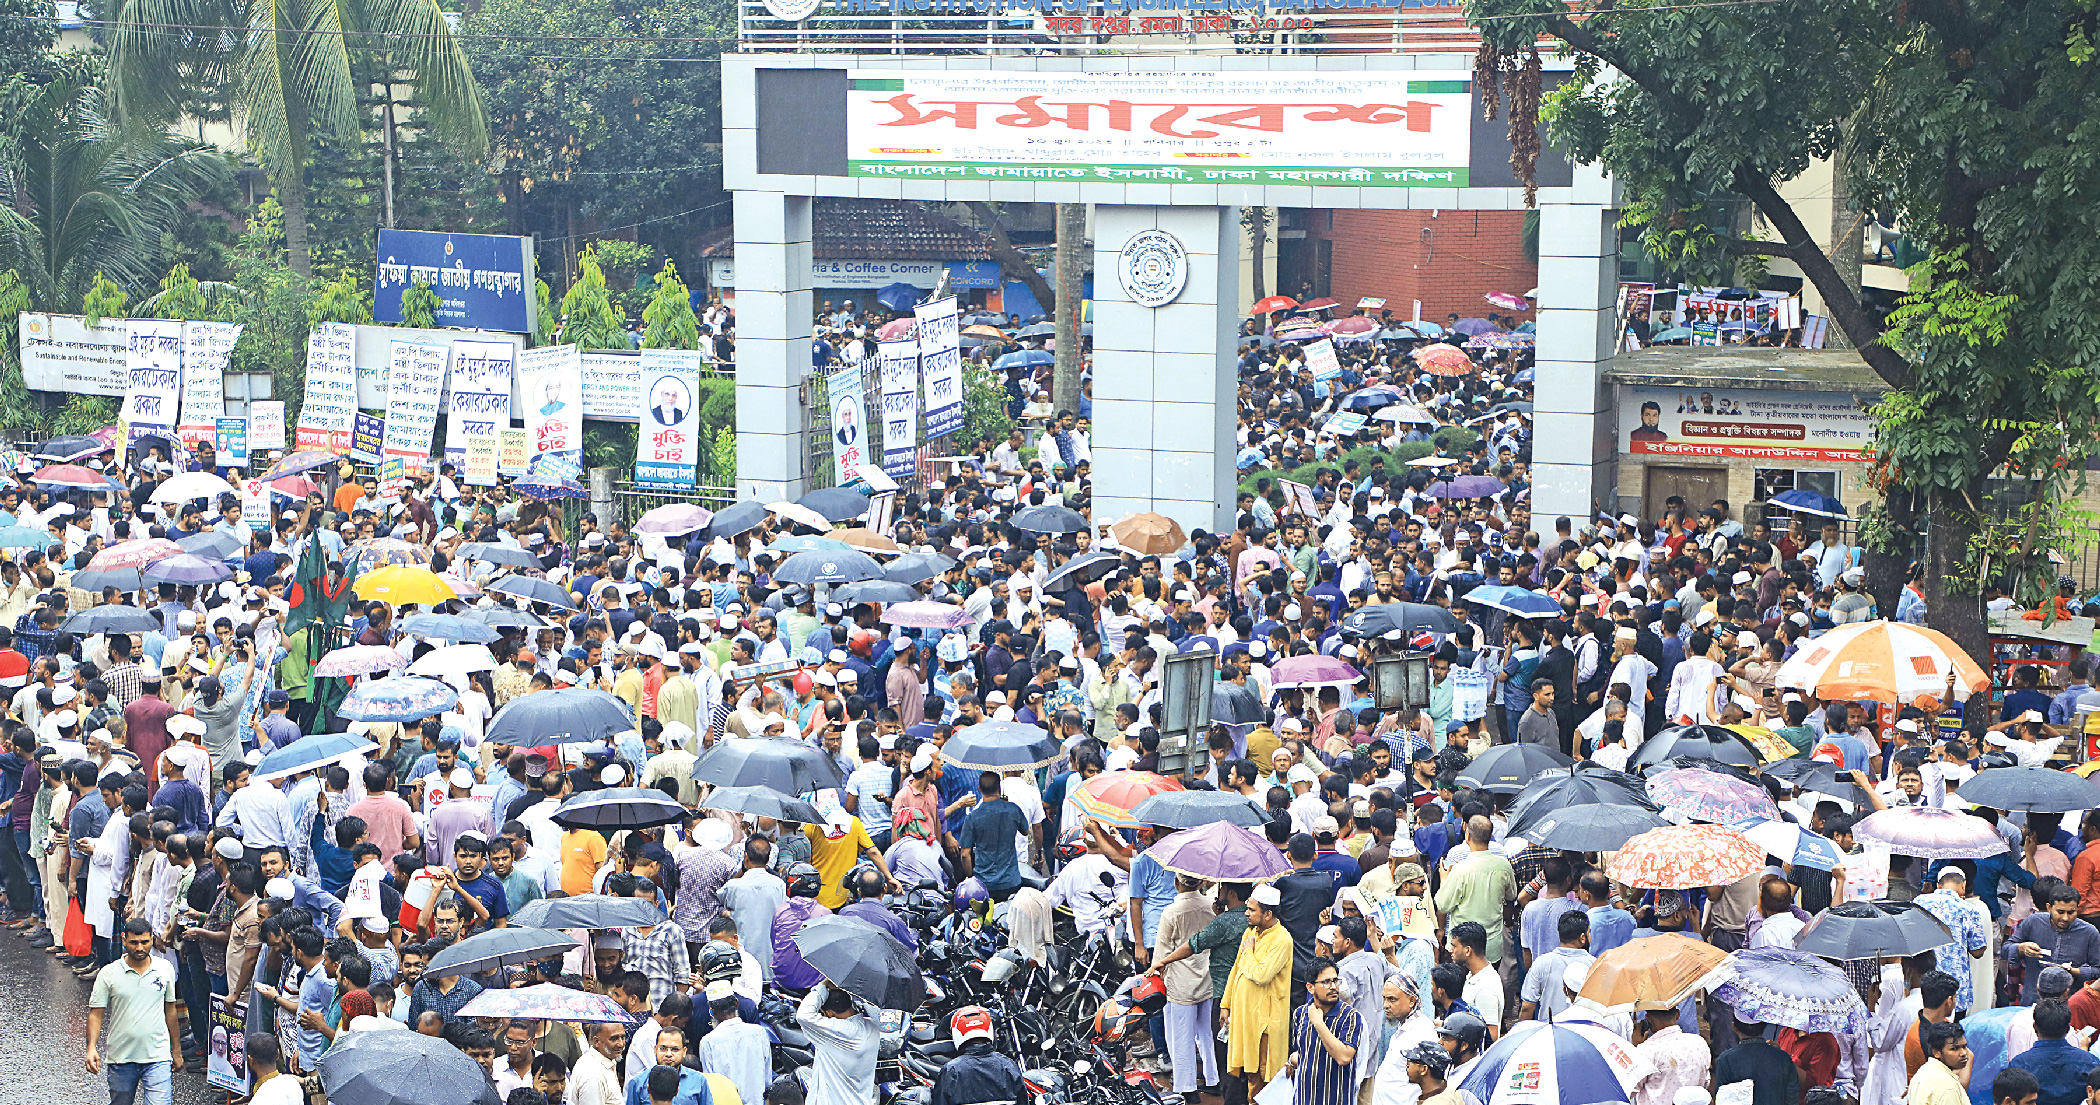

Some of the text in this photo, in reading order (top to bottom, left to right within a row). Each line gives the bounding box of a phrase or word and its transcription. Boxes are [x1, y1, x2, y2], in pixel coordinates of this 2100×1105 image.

[1043, 16, 1083, 35] সদর
[1192, 14, 1231, 35] ঢাকা
[1249, 16, 1313, 33] ১০০০
[869, 93, 1444, 139] সমাবেশ
[859, 164, 969, 177] বাংলাদেশ
[973, 165, 1089, 179] জামায়াতে
[1203, 169, 1260, 182] ঢাকা
[1265, 167, 1375, 183] মহানগরী
[1381, 169, 1457, 183] দক্ষিণ
[379, 255, 408, 289] সুফিয়া
[441, 259, 471, 291] জাতীয়
[812, 262, 935, 274] ria & Coffee Corner
[950, 276, 994, 286] CONCORD
[35, 351, 67, 361] Sustainable
[328, 351, 351, 362] টাকার
[413, 358, 440, 372] ছিলাম
[454, 352, 467, 378] এই
[488, 358, 511, 379] দরকার
[307, 380, 325, 389] দেশ
[393, 372, 440, 384] এক টাকার
[421, 386, 439, 397] নাই
[582, 383, 641, 393] NERGY AND POWER RES
[390, 399, 437, 413] দেশ রক্ষায়
[451, 384, 510, 415] কেয়ারটেকার
[389, 409, 415, 423] ইসলাম
[1818, 413, 1848, 421] বাংলাদেশ
[461, 419, 496, 437] সরকার
[535, 418, 569, 441] মুক্তি
[1685, 422, 1802, 438] বিজ্ঞান ও প্রযুক্তি বিষয়ক সম্পাদক
[1811, 428, 1838, 438] মনোনীত
[1839, 430, 1861, 439] হওয়ায়
[386, 433, 429, 451] বিকল্প নাই
[537, 435, 567, 452] চাই
[653, 428, 687, 448] মুক্তি
[653, 447, 683, 463] চাই
[840, 446, 860, 469] মুক্তি
[1644, 442, 1724, 455] ইঞ্জিনিয়ার
[1728, 444, 1820, 459] আলাউদ্দিন
[229, 1031, 245, 1052] মুক্তি
[230, 1050, 244, 1069] চাই
